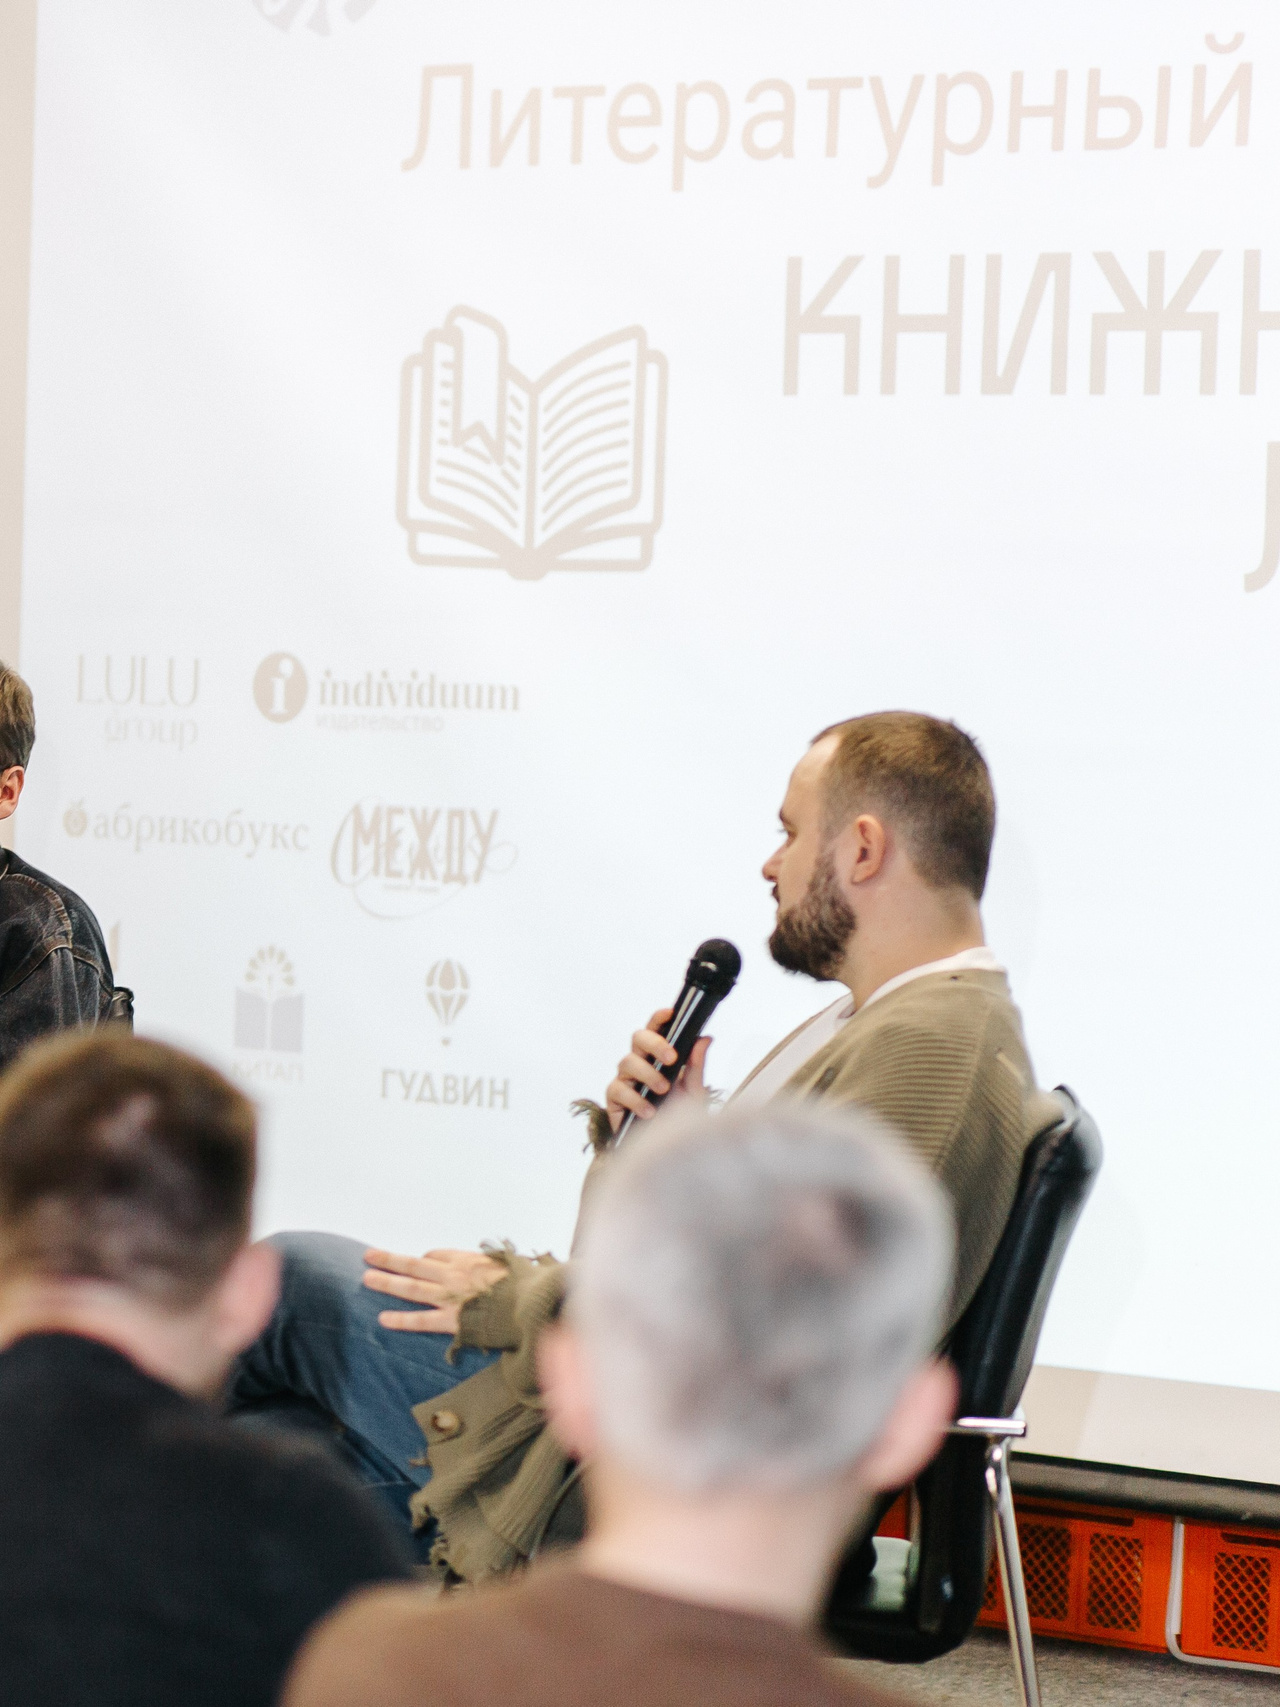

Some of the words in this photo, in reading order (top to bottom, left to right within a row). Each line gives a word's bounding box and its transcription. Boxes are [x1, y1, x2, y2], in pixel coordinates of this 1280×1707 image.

[401, 31, 1255, 192] Литературный
[75, 653, 201, 707] LULU
[318, 667, 521, 712] individuum
[103, 710, 199, 752] group
[93, 801, 311, 860] абрикобукс
[350, 803, 500, 887] МЕЖДУ
[381, 1066, 511, 1110] ГУДВИН
